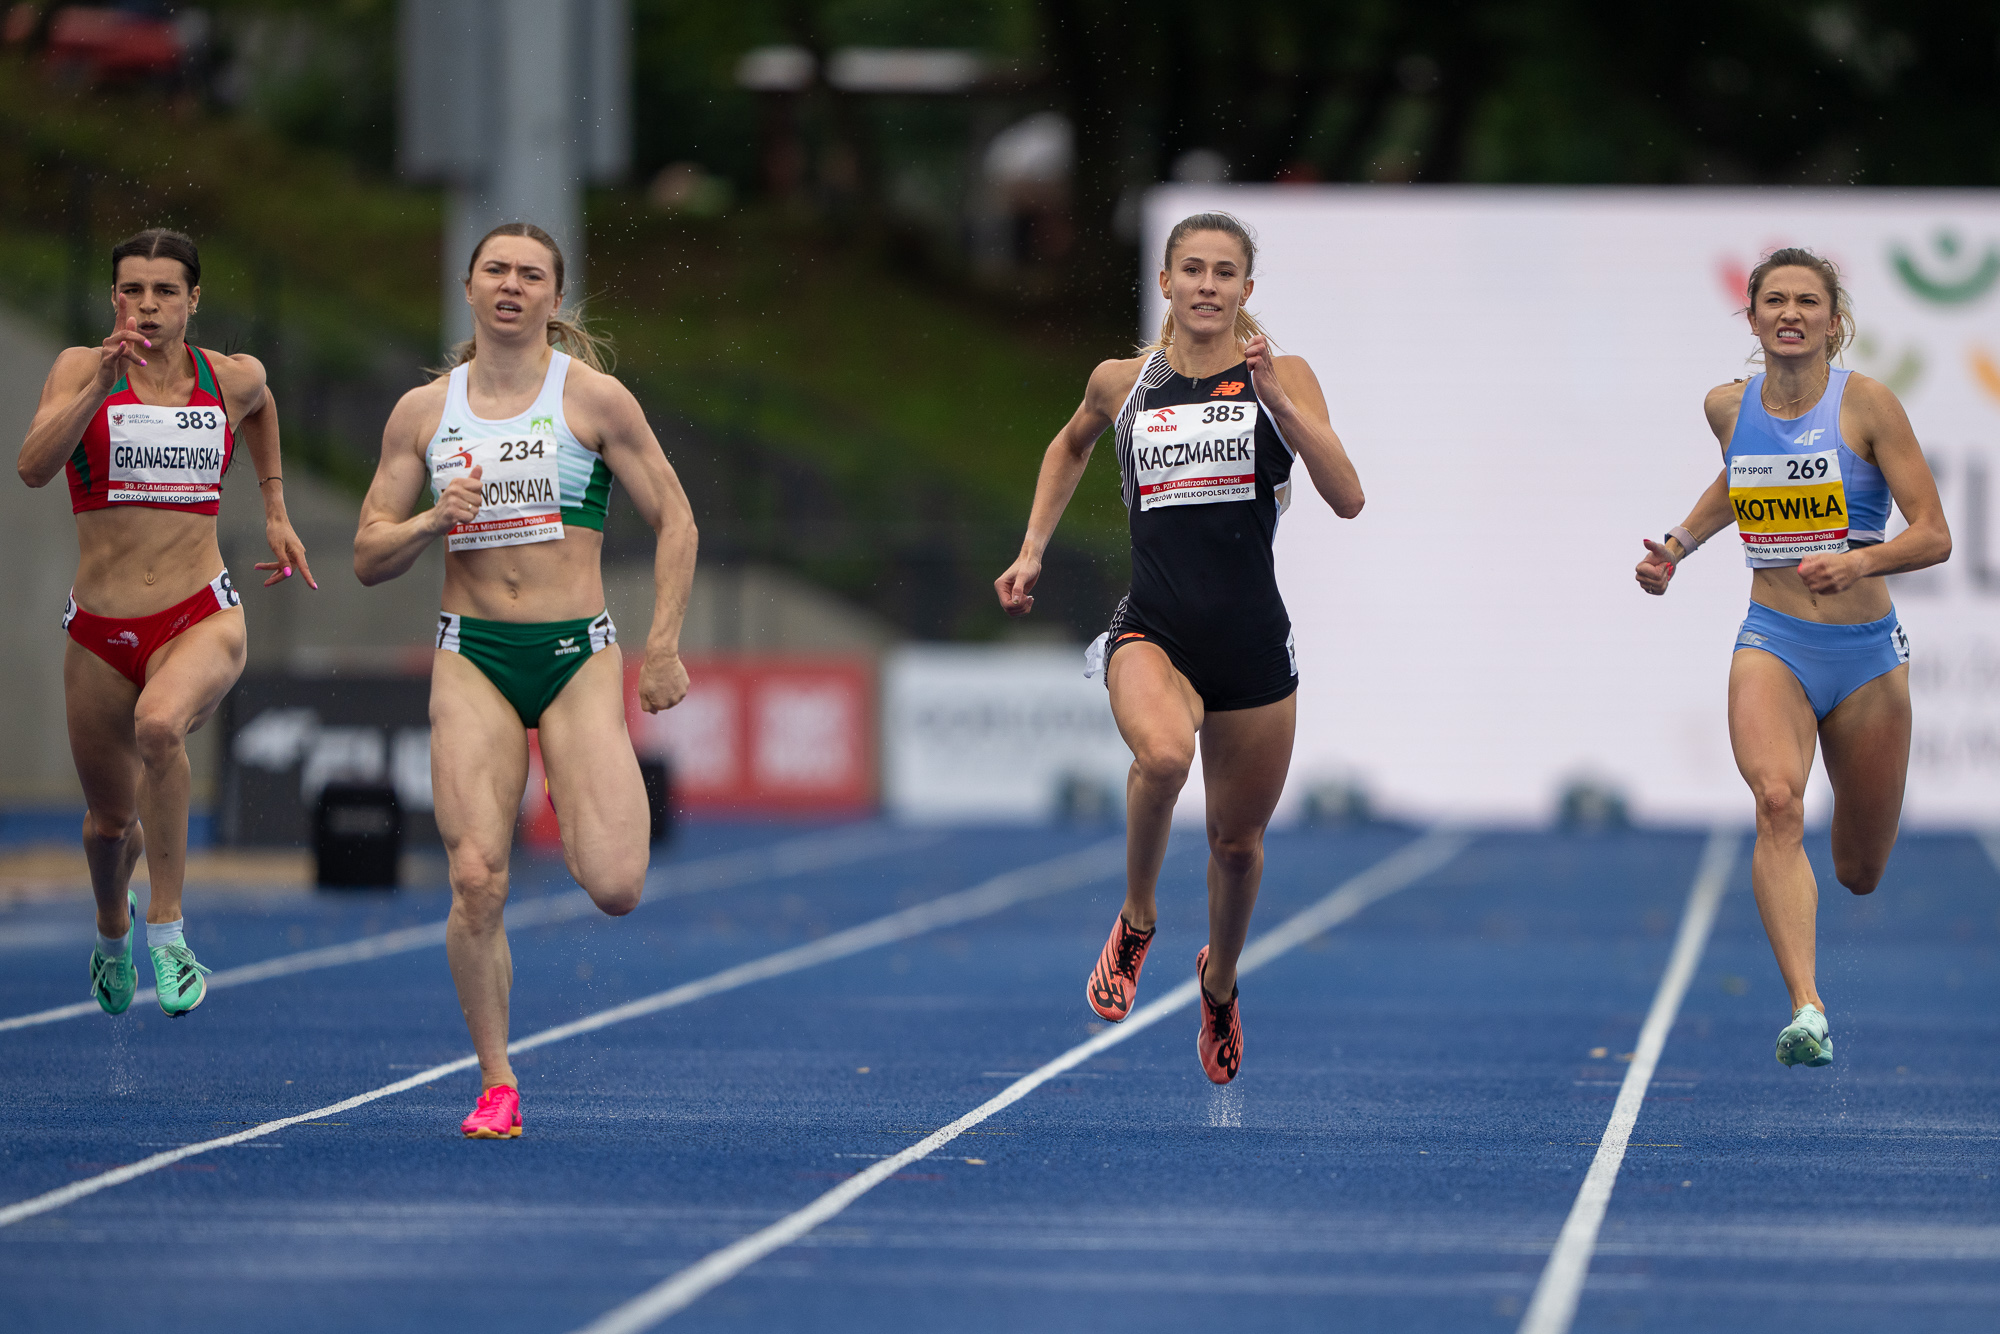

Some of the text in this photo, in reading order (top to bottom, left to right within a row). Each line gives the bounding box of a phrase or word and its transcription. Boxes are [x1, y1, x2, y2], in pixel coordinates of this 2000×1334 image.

[175, 411, 217, 429] 383
[1202, 405, 1245, 424] 385
[1147, 424, 1177, 433] ORLEN
[441, 435, 463, 443] erima
[1794, 429, 1825, 446] 4F
[115, 446, 219, 470] GRANASZEWSKA
[500, 440, 544, 462] 234
[1138, 437, 1250, 471] KACZMAREK
[436, 459, 464, 472] polanik
[1733, 466, 1773, 475] TVP SPORT
[1786, 457, 1828, 480] 269
[124, 482, 136, 490] 99.
[137, 483, 152, 491] PZLA
[154, 484, 194, 492] Mistrzostwa
[1163, 482, 1176, 490] PZLA
[1177, 479, 1218, 488] Mistrzostwa
[1219, 476, 1240, 484] Polski
[114, 492, 150, 501] GORZÓW
[441, 478, 554, 507] NOUSKAYA
[1146, 486, 1250, 504] GORZÓW WIELKOPOLSKI 2023
[1734, 494, 1843, 521] KOTWIŁA
[480, 520, 523, 530] Mistrzostwa
[524, 516, 546, 525] Polski
[479, 530, 537, 543] WIELKOPOLSKI
[538, 526, 558, 535] 2023
[1773, 535, 1814, 543] Mistrzostwa
[1814, 532, 1835, 540] Polski
[1772, 544, 1826, 553] WIELKOPOLSKI
[220, 572, 238, 607] 8
[439, 615, 452, 649] 7
[554, 645, 581, 656] erima
